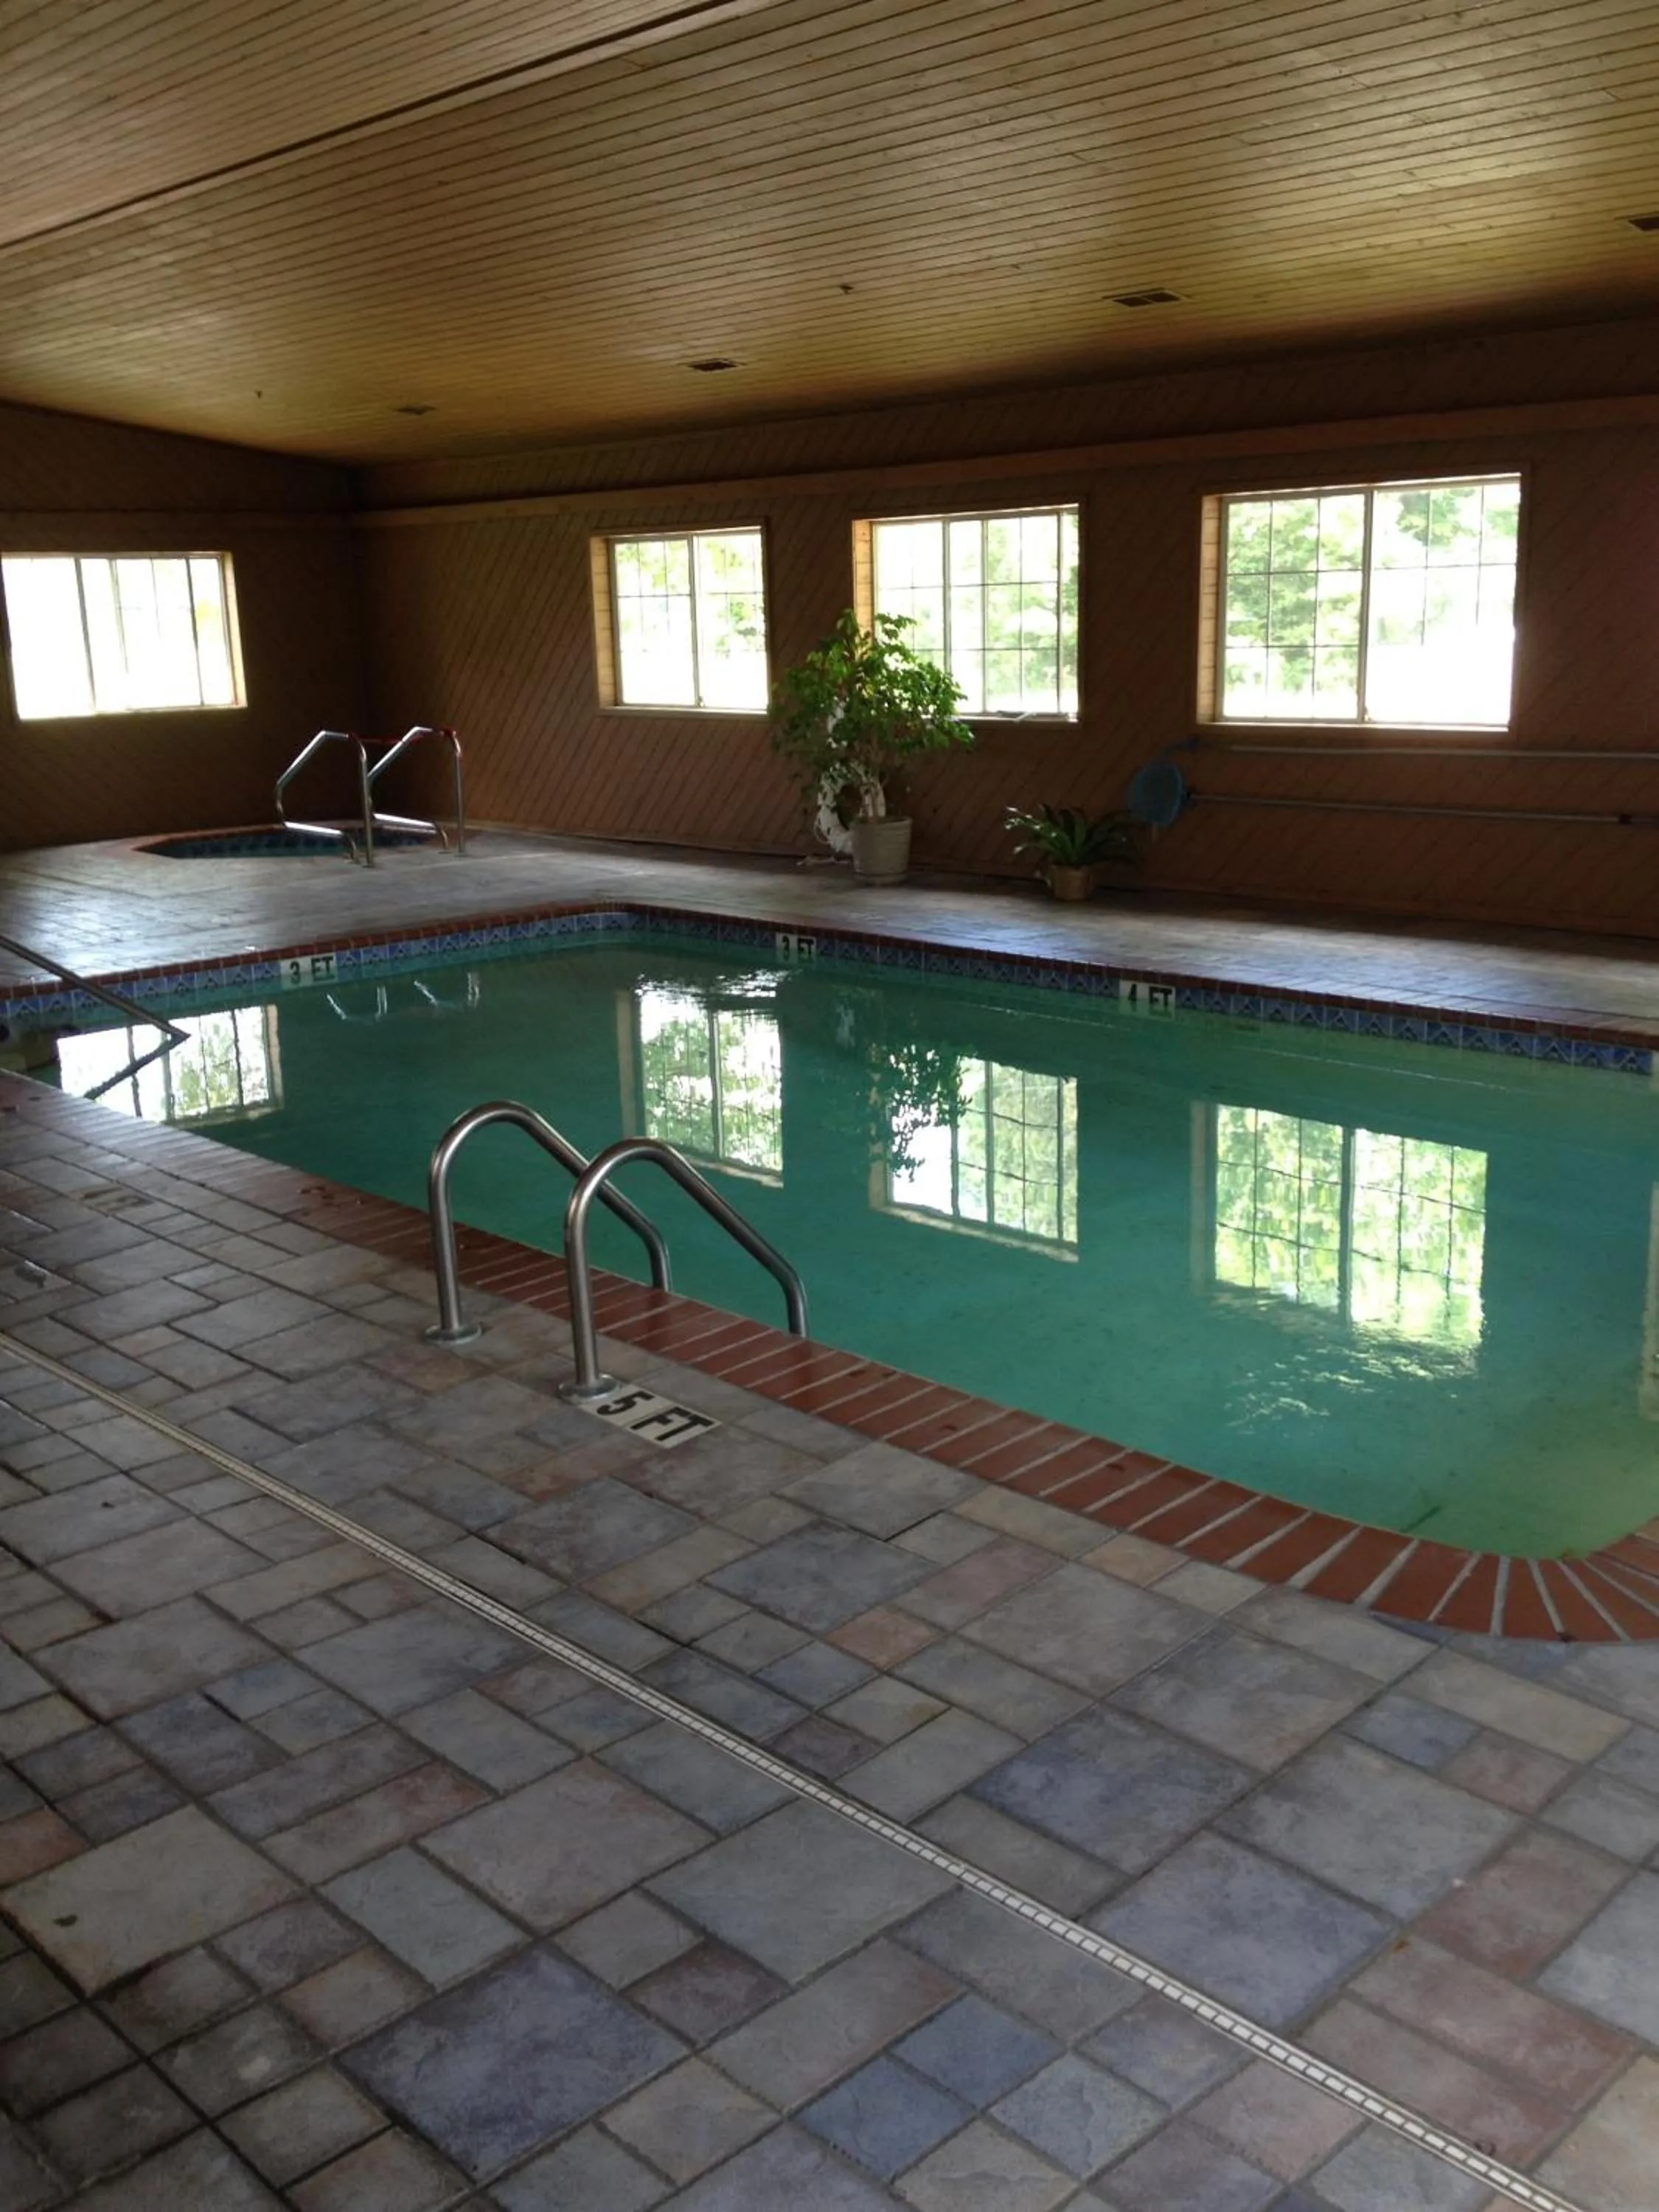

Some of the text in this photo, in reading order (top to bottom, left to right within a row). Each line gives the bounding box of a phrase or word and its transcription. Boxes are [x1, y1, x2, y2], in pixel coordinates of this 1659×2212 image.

[798, 937, 814, 956] FT
[290, 956, 334, 981] 3 FT
[1127, 984, 1172, 1008] 4 FT
[597, 1391, 714, 1441] 5 FT
